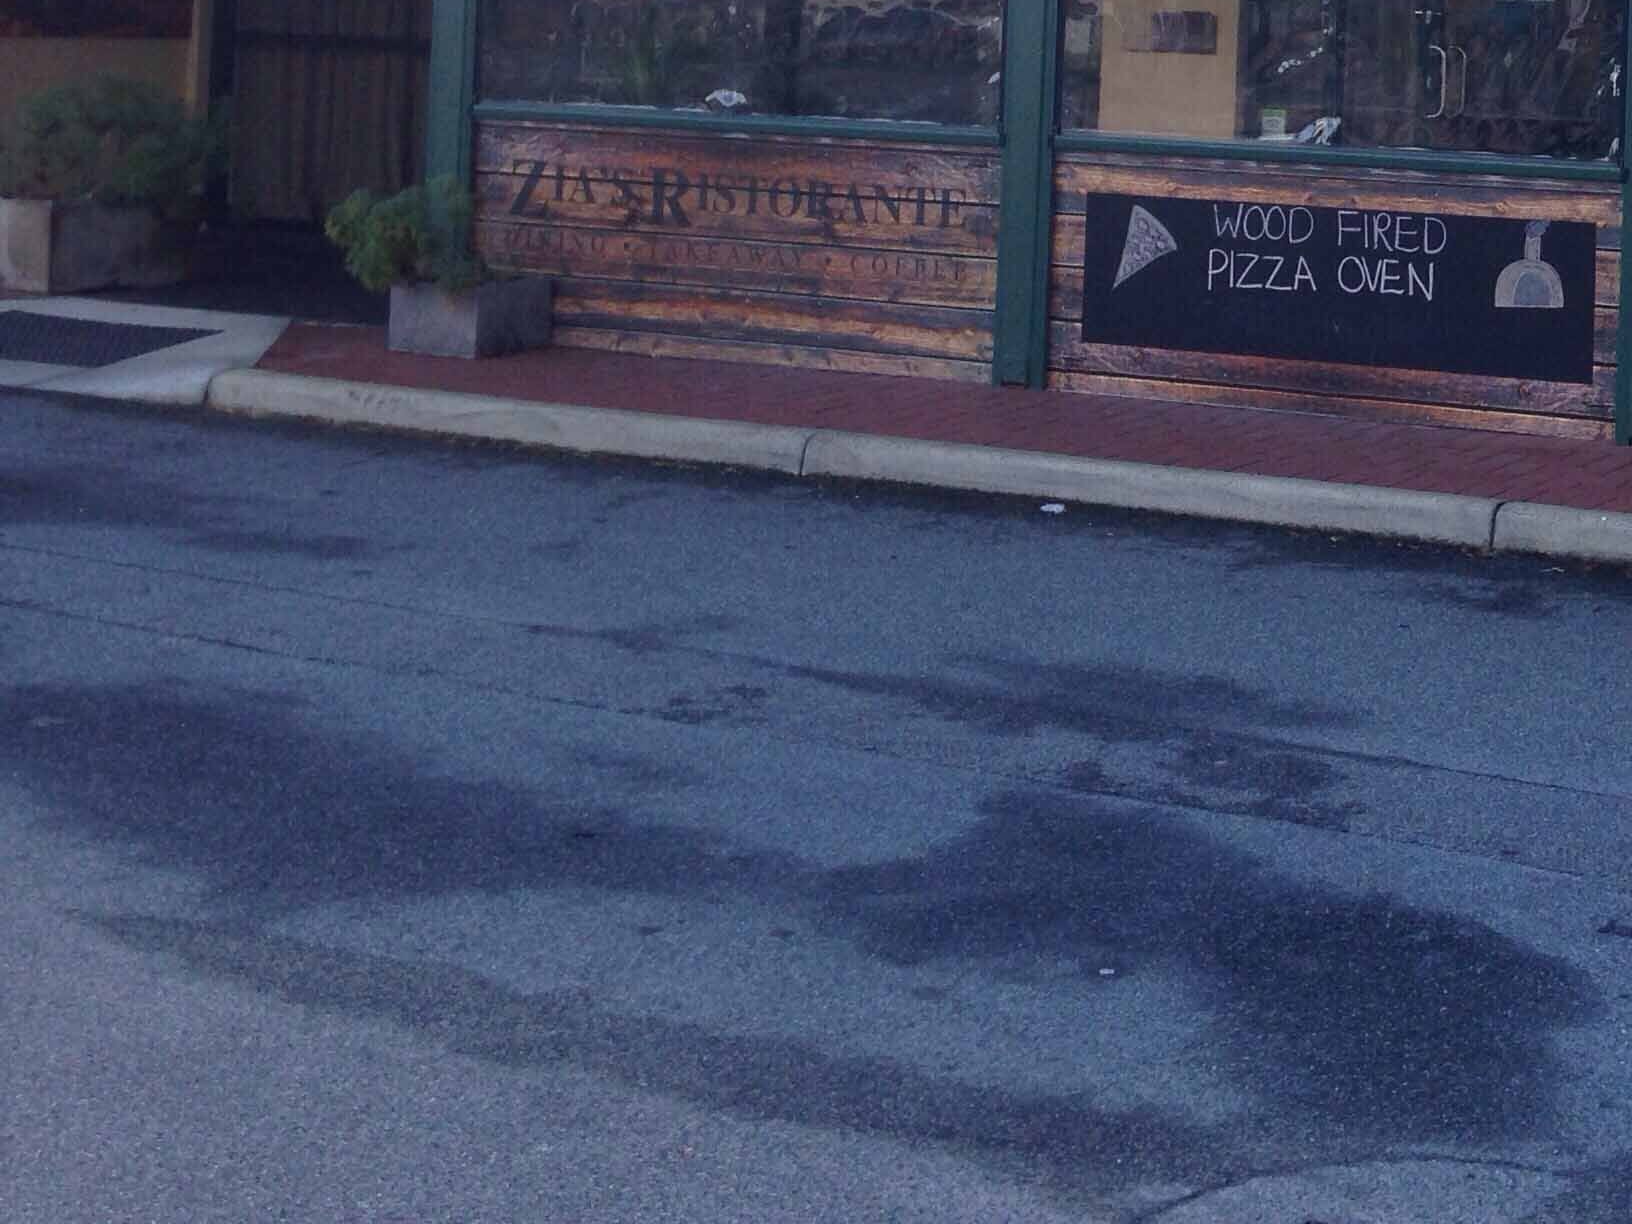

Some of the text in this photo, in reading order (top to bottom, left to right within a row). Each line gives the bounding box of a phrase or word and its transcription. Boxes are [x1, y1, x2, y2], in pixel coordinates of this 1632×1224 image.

[649, 166, 968, 228] RISTORANTE
[1212, 203, 1447, 254] WOOD FIRED
[1207, 249, 1434, 302] PIZZA OVEN
